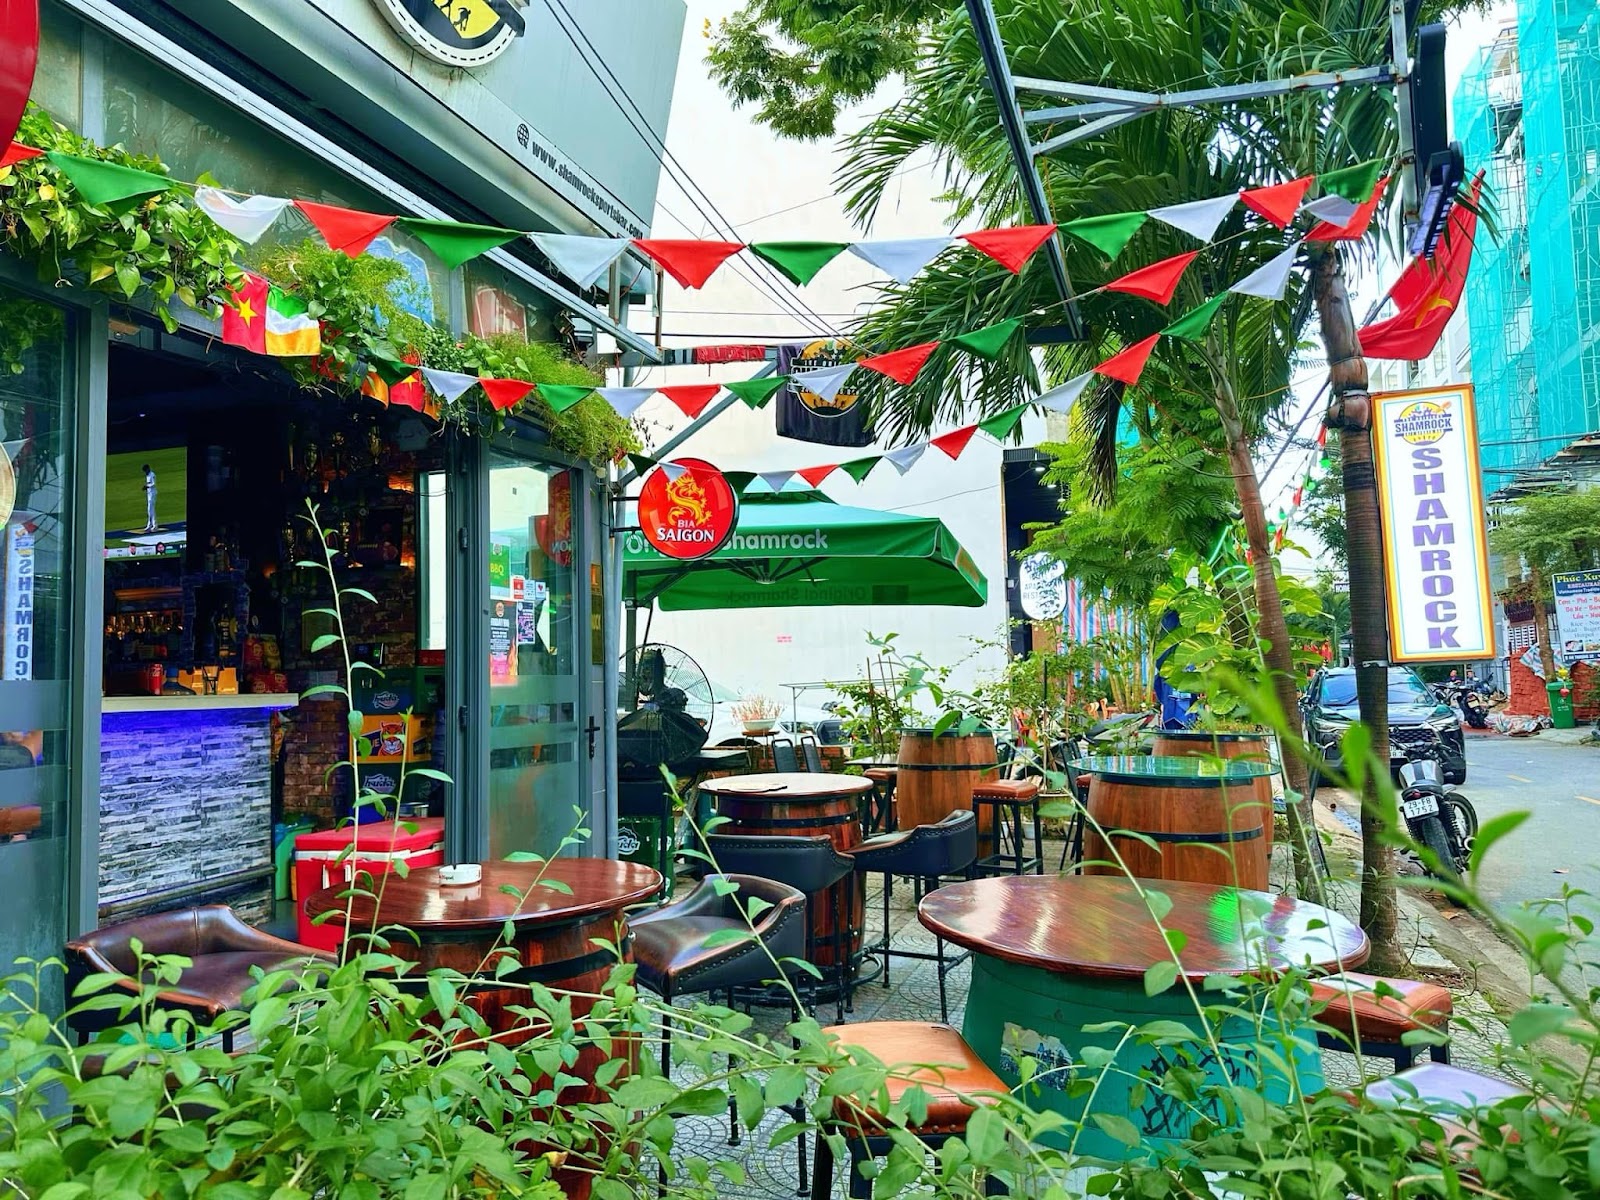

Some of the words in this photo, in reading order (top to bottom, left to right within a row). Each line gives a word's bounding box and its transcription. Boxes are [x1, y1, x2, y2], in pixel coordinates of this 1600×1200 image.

[1395, 418, 1452, 433] SHAMROCK
[677, 519, 695, 528] BIA
[657, 527, 715, 542] SAIGON
[1412, 448, 1461, 649] SHAMROCK
